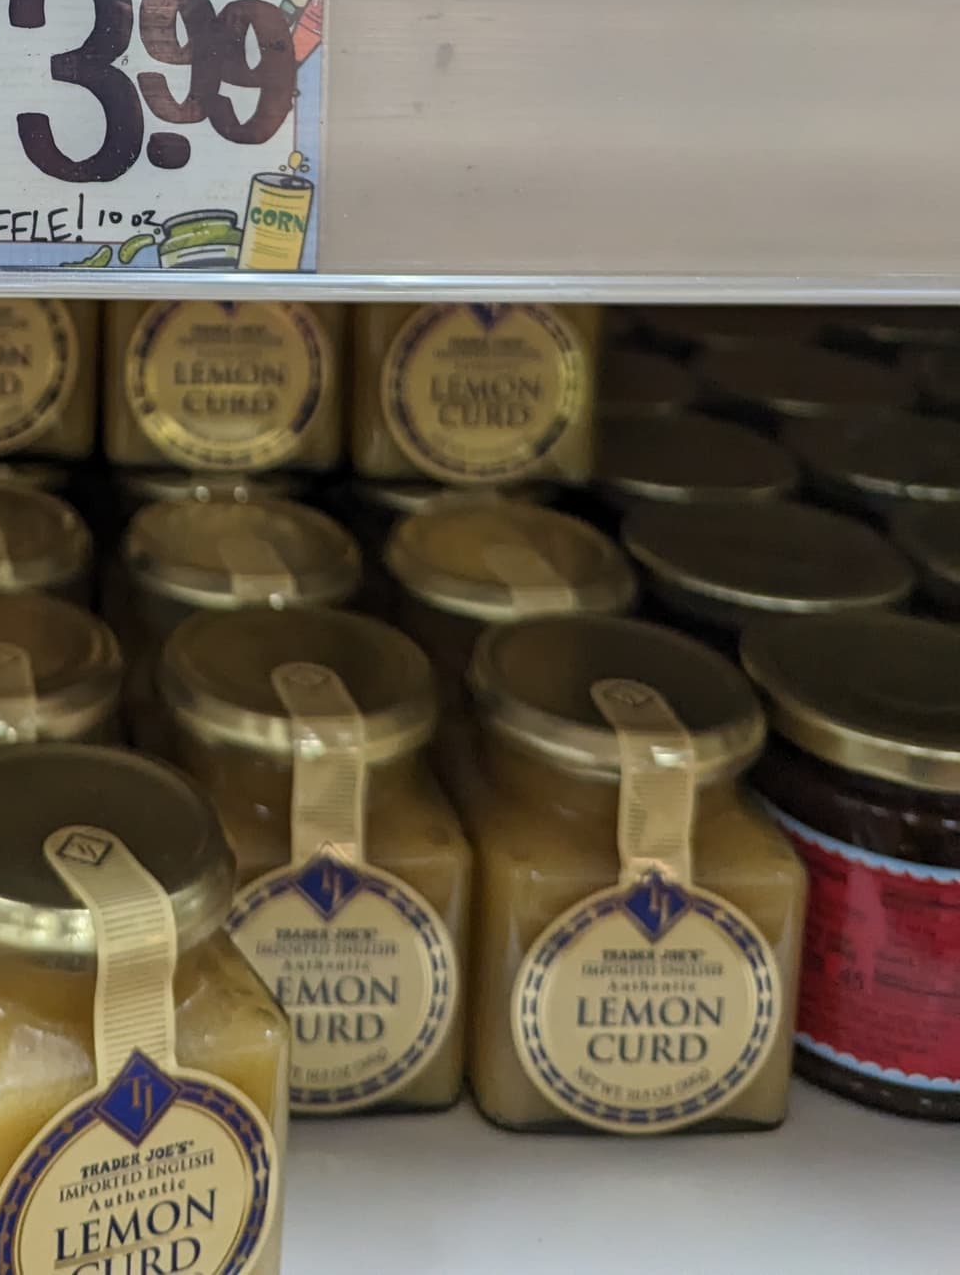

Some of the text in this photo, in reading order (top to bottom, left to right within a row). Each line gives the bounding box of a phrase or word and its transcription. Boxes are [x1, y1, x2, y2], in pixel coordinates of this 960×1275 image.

[98, 209, 122, 227] 10
[249, 206, 307, 234] CORN
[173, 360, 286, 386] LEMON
[430, 374, 543, 401] LEMON
[181, 390, 278, 416] CURD
[439, 403, 532, 429] CURD
[275, 974, 401, 1006] EMON
[576, 995, 726, 1027] LEMON
[294, 1011, 385, 1045] URD
[586, 1032, 709, 1064] CURD
[59, 1151, 215, 1203] IMPORTED ENGLISH
[80, 1151, 141, 1180] TRADER
[88, 1177, 187, 1214] Authentic
[54, 1188, 218, 1261] LEMON
